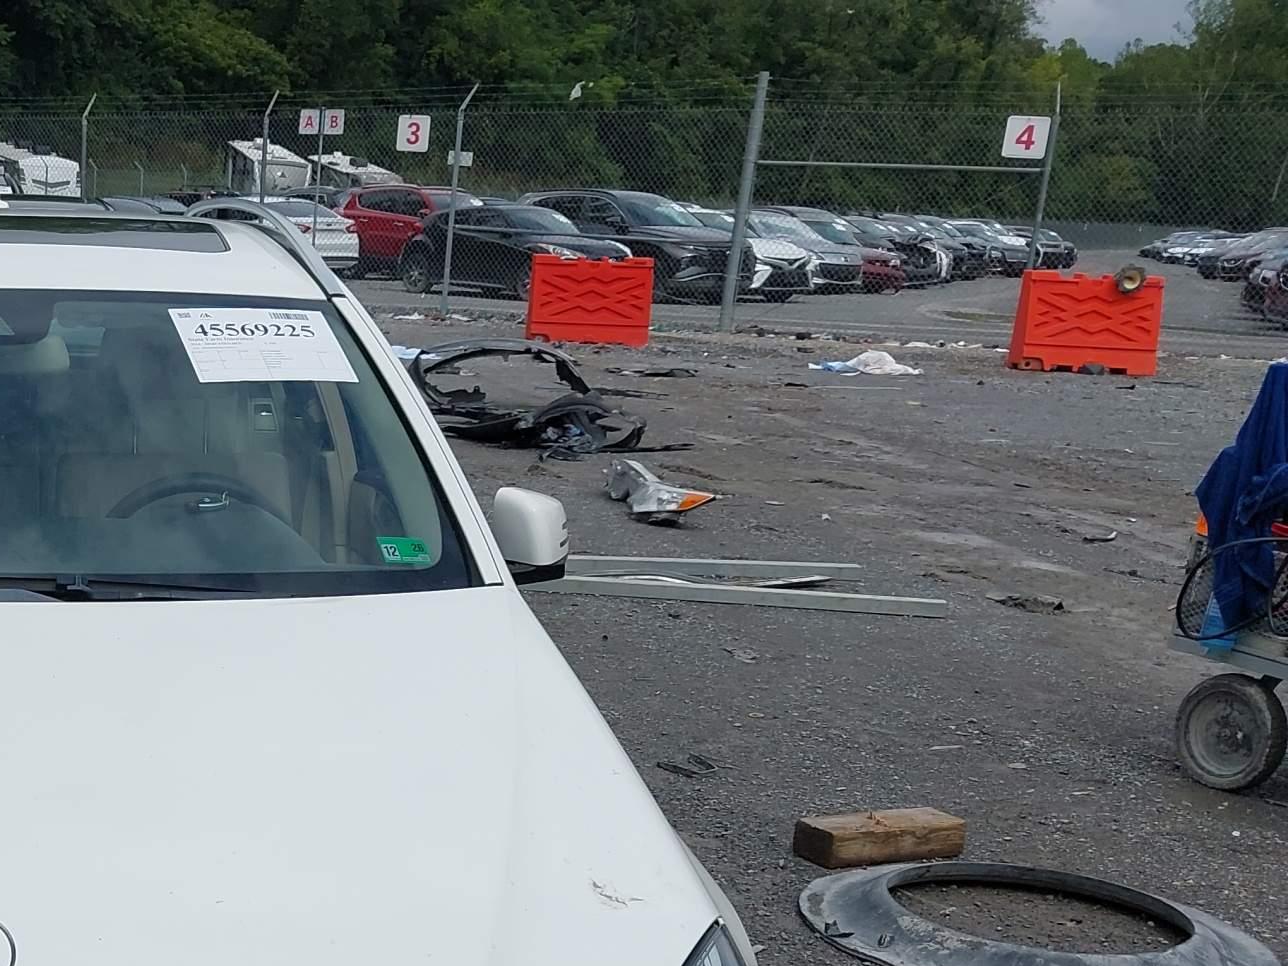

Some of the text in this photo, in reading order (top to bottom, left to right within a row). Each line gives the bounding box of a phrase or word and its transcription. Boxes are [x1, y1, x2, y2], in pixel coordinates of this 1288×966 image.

[304, 115, 314, 129] A
[330, 115, 339, 129] B
[406, 122, 420, 145] 3
[1015, 124, 1035, 150] 4
[194, 323, 315, 338] 45569225
[384, 545, 399, 557] 12
